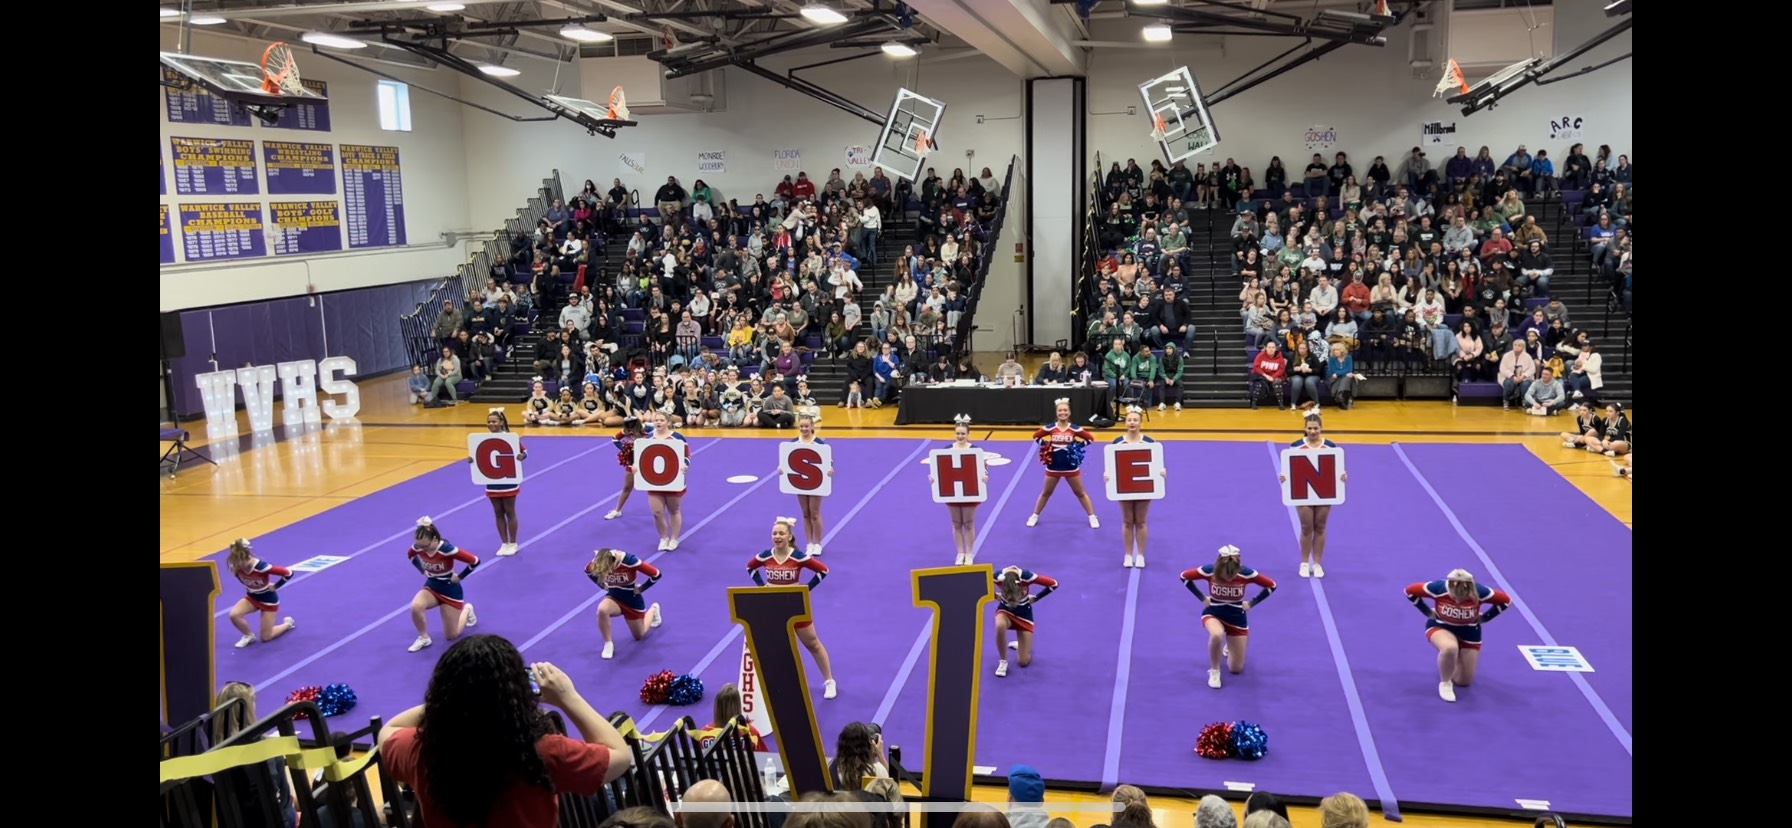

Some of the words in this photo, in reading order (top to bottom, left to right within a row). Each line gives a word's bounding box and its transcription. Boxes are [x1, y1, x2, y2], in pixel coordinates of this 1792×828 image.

[1551, 116, 1583, 133] ARC
[1305, 131, 1337, 142] GOSHEN
[171, 137, 216, 147] WARWICK
[222, 140, 253, 149] VALLEY
[263, 142, 302, 150] WARWICK
[208, 147, 252, 155] SWIMMING
[341, 145, 373, 153] WARWICK
[180, 153, 250, 161] CHAMPIONS
[774, 150, 800, 159] FLORIDA
[180, 204, 226, 212] WARWICK
[229, 203, 261, 211] VALLEY
[271, 202, 308, 210] WARWICK
[310, 201, 338, 209] VALLEY
[199, 211, 246, 219] BASEBALL
[276, 209, 306, 217] BOYS'
[309, 208, 335, 216] GOLF
[188, 218, 257, 226] CHAMPIONS
[277, 215, 335, 224] CHAMPIONS
[195, 355, 361, 439] WVHS
[476, 438, 516, 480] G
[638, 443, 680, 487] O
[786, 448, 824, 491] S
[936, 454, 979, 498] H
[1114, 448, 1155, 493] E
[1289, 454, 1338, 500] N
[1211, 584, 1244, 597] GOSHEN
[1441, 606, 1476, 620] GOSHEN
[1528, 648, 1583, 668] BLUE
[742, 653, 754, 713] GHS
